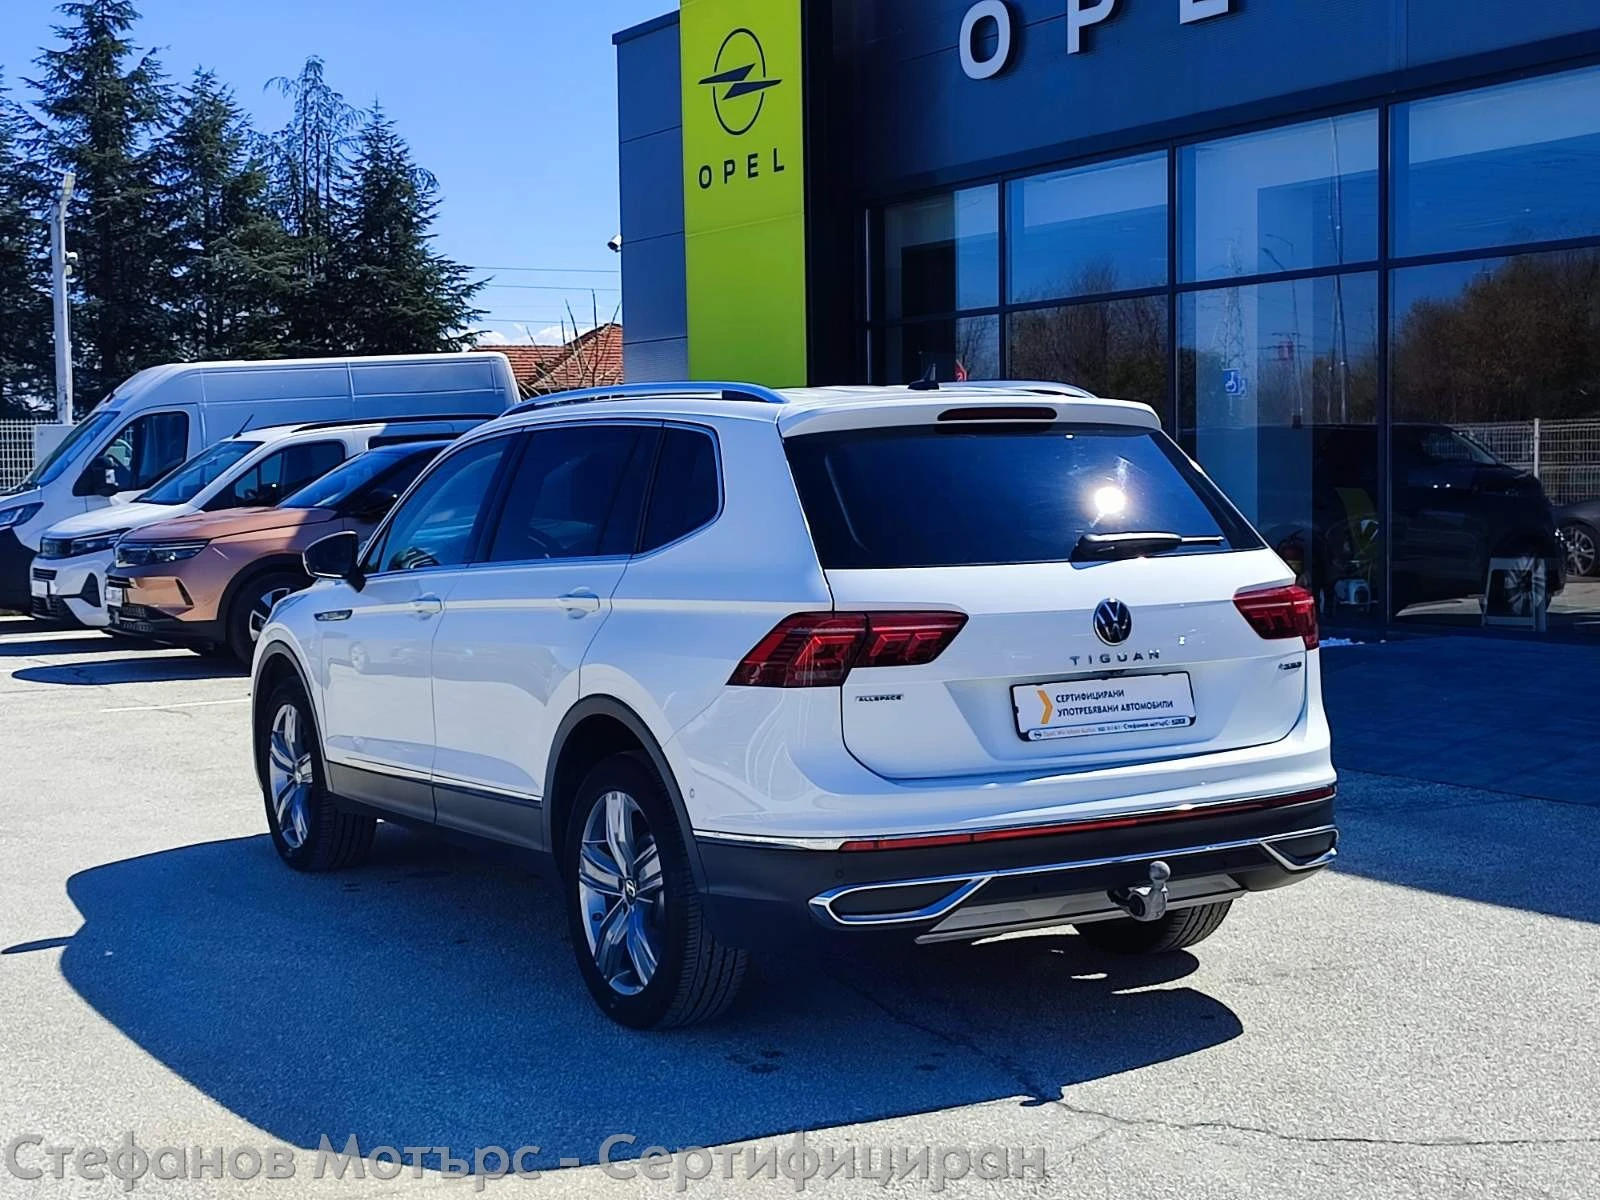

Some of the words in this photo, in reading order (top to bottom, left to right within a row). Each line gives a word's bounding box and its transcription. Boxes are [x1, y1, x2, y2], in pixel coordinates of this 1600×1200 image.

[698, 147, 785, 190] OPEL
[1069, 649, 1160, 666] TIGUAN
[858, 694, 903, 702] ALLSPACE
[1055, 689, 1125, 703] СЕРТИФИЦИРАНИ
[1057, 704, 1119, 717] УПОТРЕБЯВАНИ
[1120, 700, 1174, 712] АВТОМОБИЛИ
